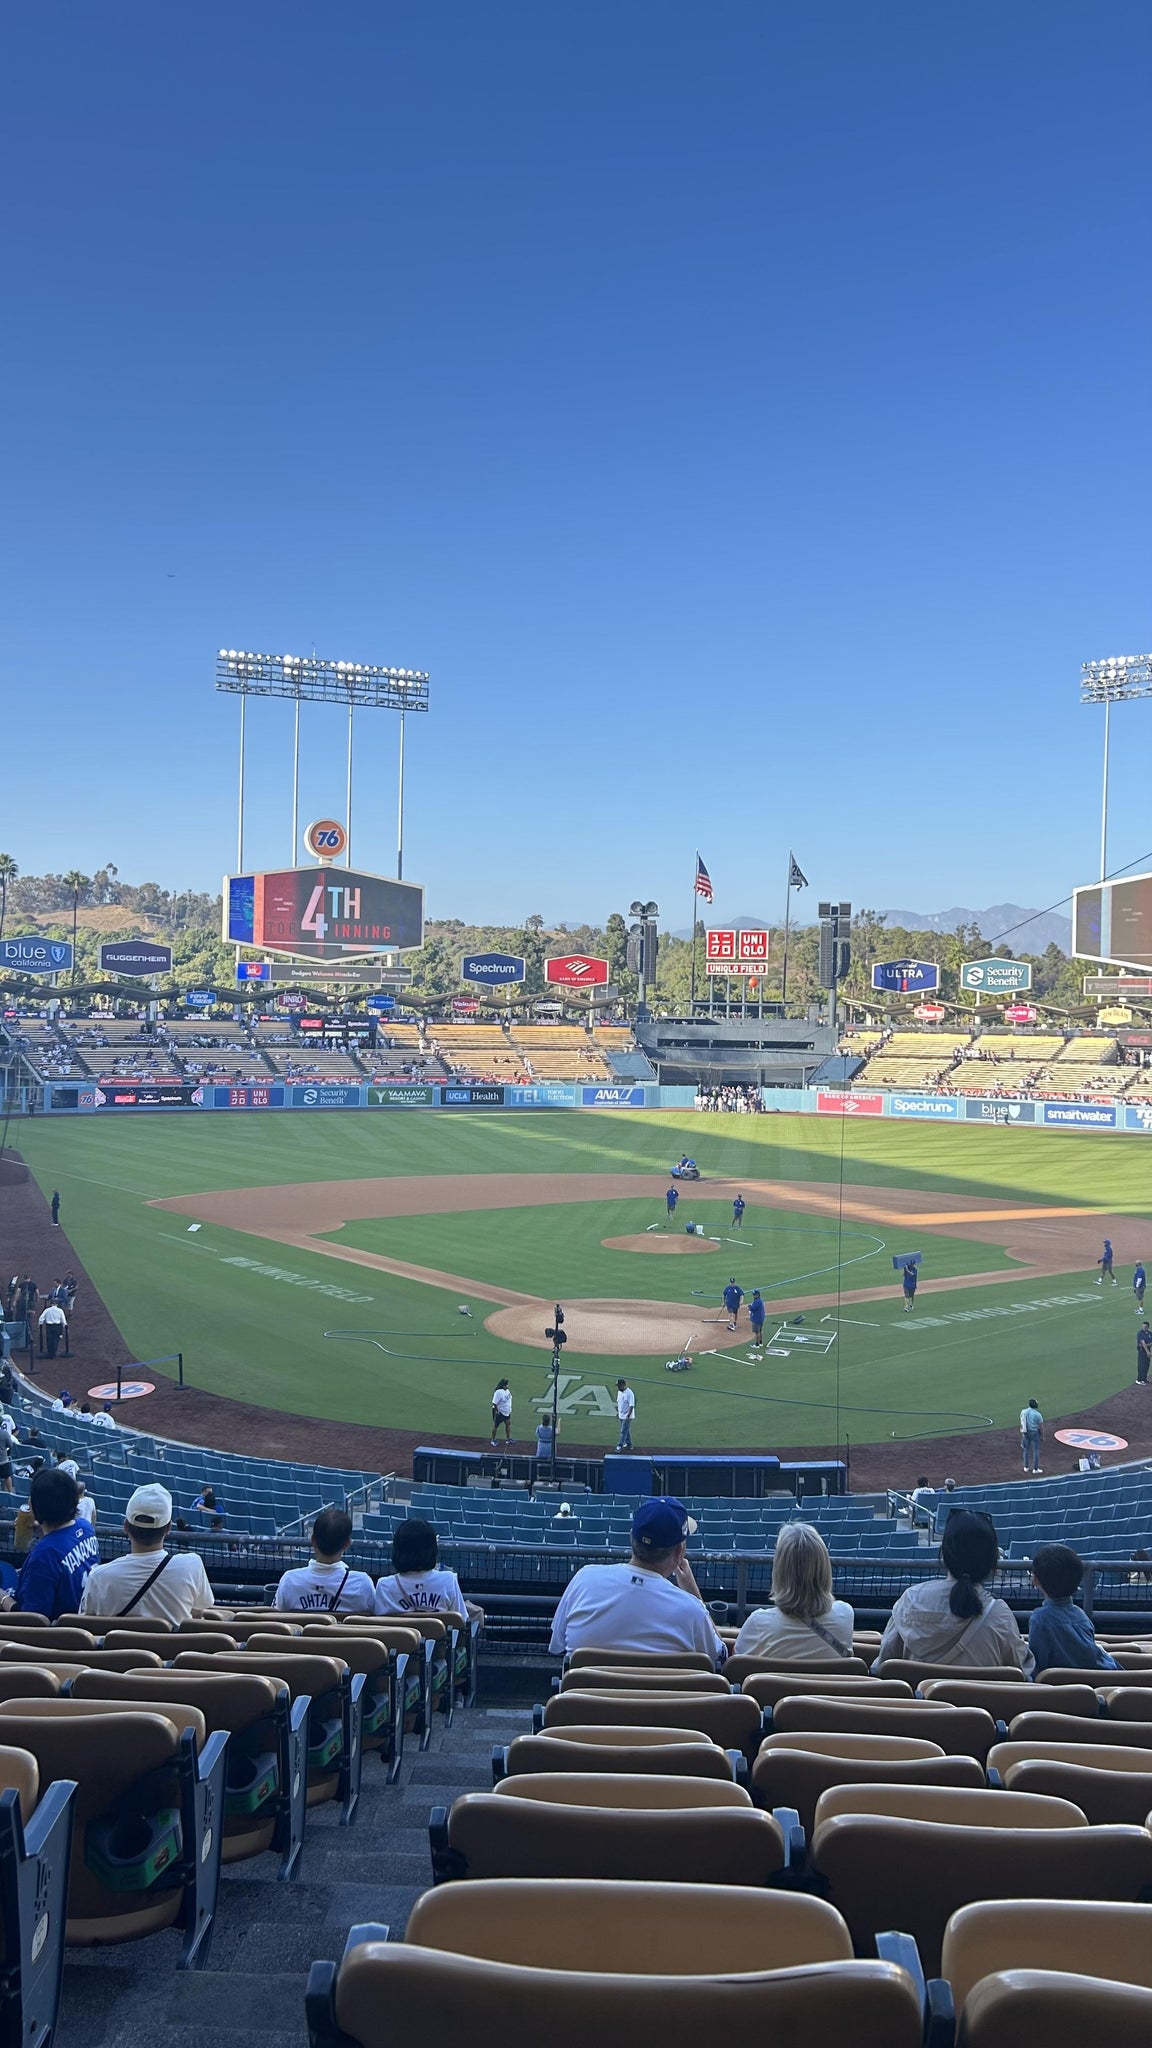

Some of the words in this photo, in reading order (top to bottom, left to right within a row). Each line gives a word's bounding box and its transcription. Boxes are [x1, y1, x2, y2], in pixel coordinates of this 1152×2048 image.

[317, 830, 340, 847] 76
[335, 924, 391, 939] INNING
[743, 935, 762, 944] UNI
[5, 943, 46, 959] blue
[743, 946, 764, 956] QLO
[11, 959, 51, 967] california
[106, 954, 167, 963] GUGGENHEIM
[469, 963, 516, 974] Spectrum
[709, 965, 739, 973] UNIQLO
[740, 965, 764, 973] FIELD
[886, 969, 924, 978] ULTRA
[987, 966, 1024, 977] Security
[987, 977, 1018, 986] Benefit
[320, 1089, 349, 1097] Security
[449, 1092, 468, 1100] UCLA
[472, 1092, 499, 1100] Health
[514, 1090, 543, 1103] TEL
[594, 1090, 619, 1100] ANA
[80, 1095, 93, 1104] 76
[894, 1100, 949, 1113] Spectrum
[981, 1103, 1008, 1114] blue
[1047, 1109, 1113, 1122] smartwater
[310, 1284, 375, 1303] FIELD
[942, 1304, 1038, 1322] UNIQLO
[1029, 1293, 1104, 1308] FIELD
[101, 1385, 145, 1396] 76
[531, 1374, 618, 1416] LA
[1068, 1433, 1118, 1446] 76
